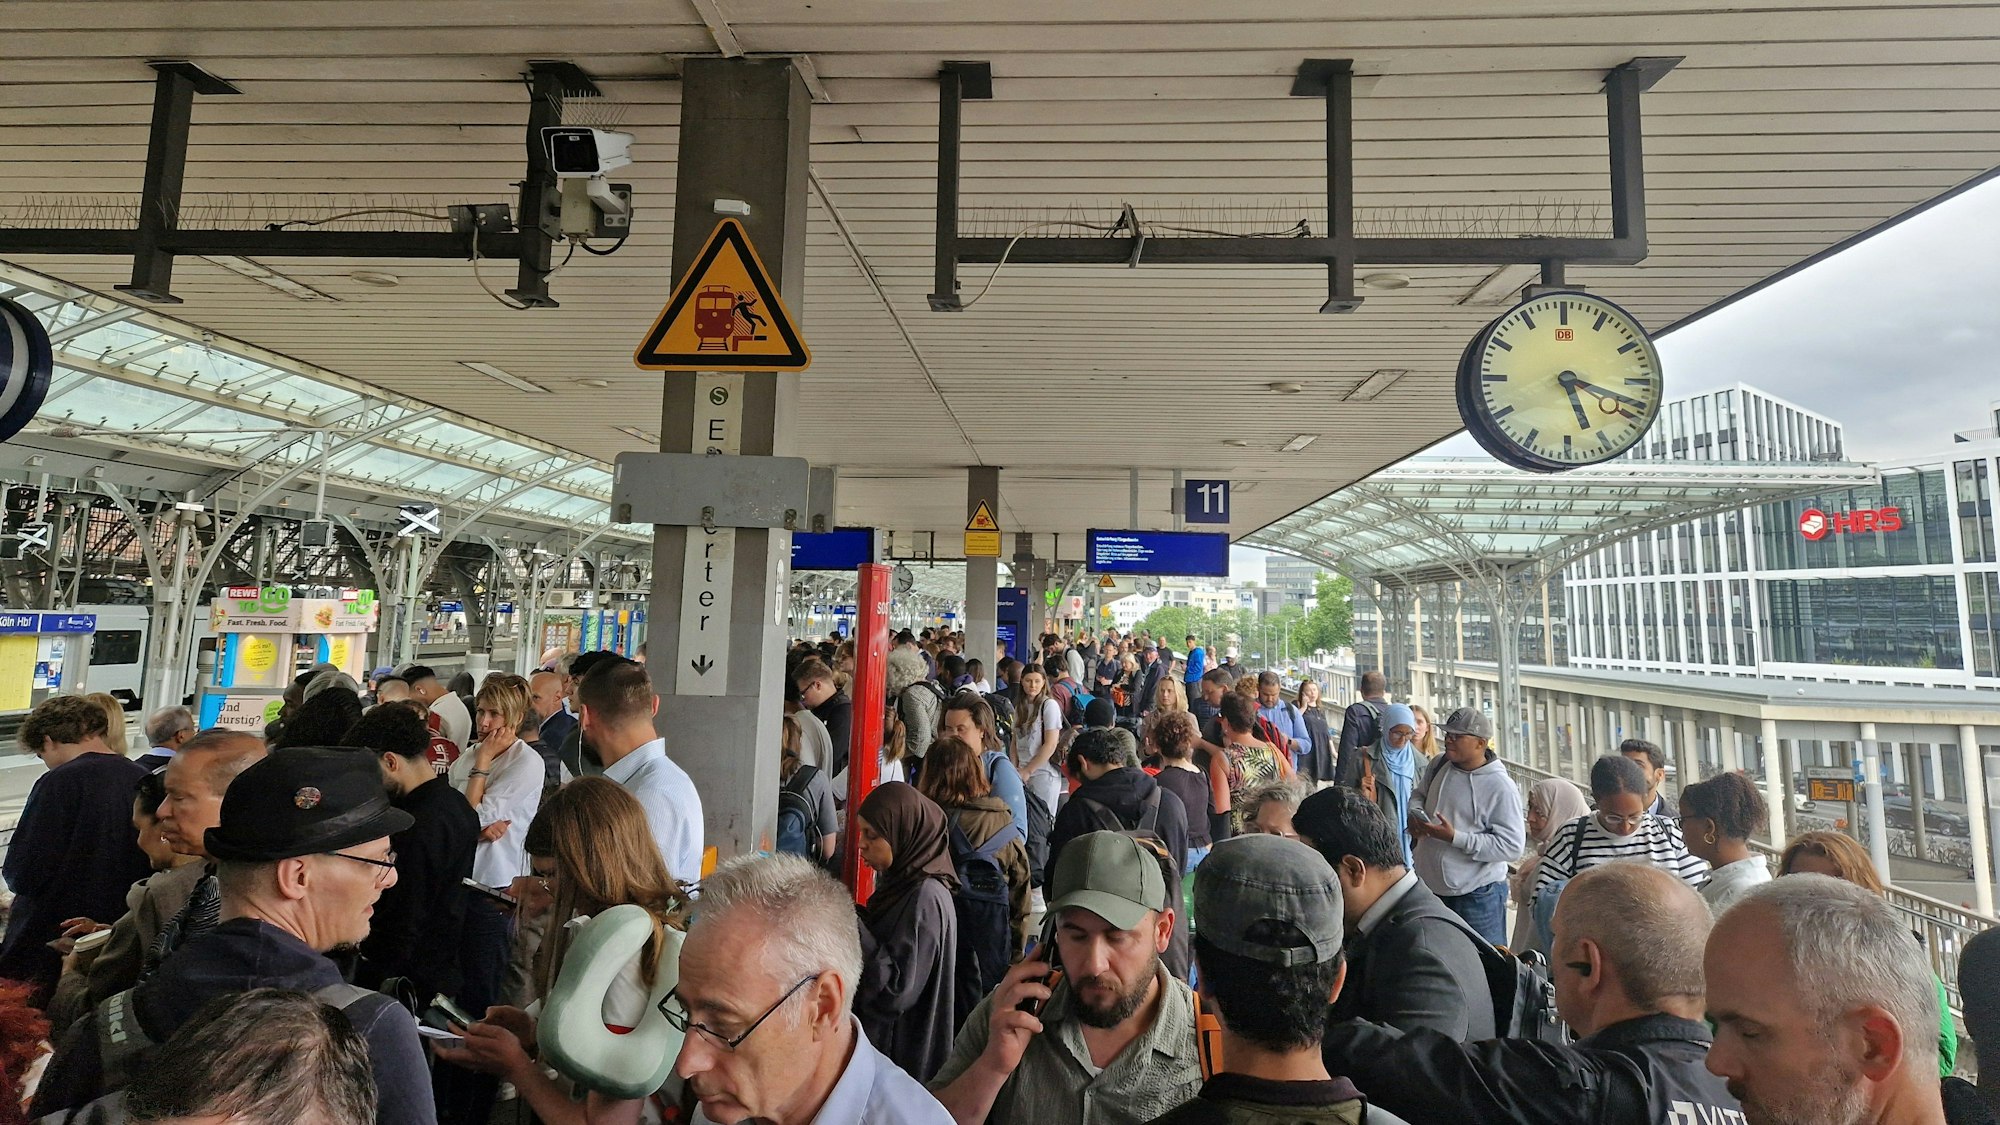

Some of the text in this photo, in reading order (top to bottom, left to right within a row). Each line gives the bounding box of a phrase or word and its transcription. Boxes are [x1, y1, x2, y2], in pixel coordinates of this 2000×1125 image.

[1557, 330, 1571, 339] DB
[711, 387, 727, 405] S
[1197, 483, 1224, 514] 11
[1834, 507, 1902, 533] HRS
[230, 587, 289, 613] REWE TO GO
[17, 616, 32, 627] Hbf
[219, 702, 240, 712] Und
[216, 715, 261, 726] durstig?
